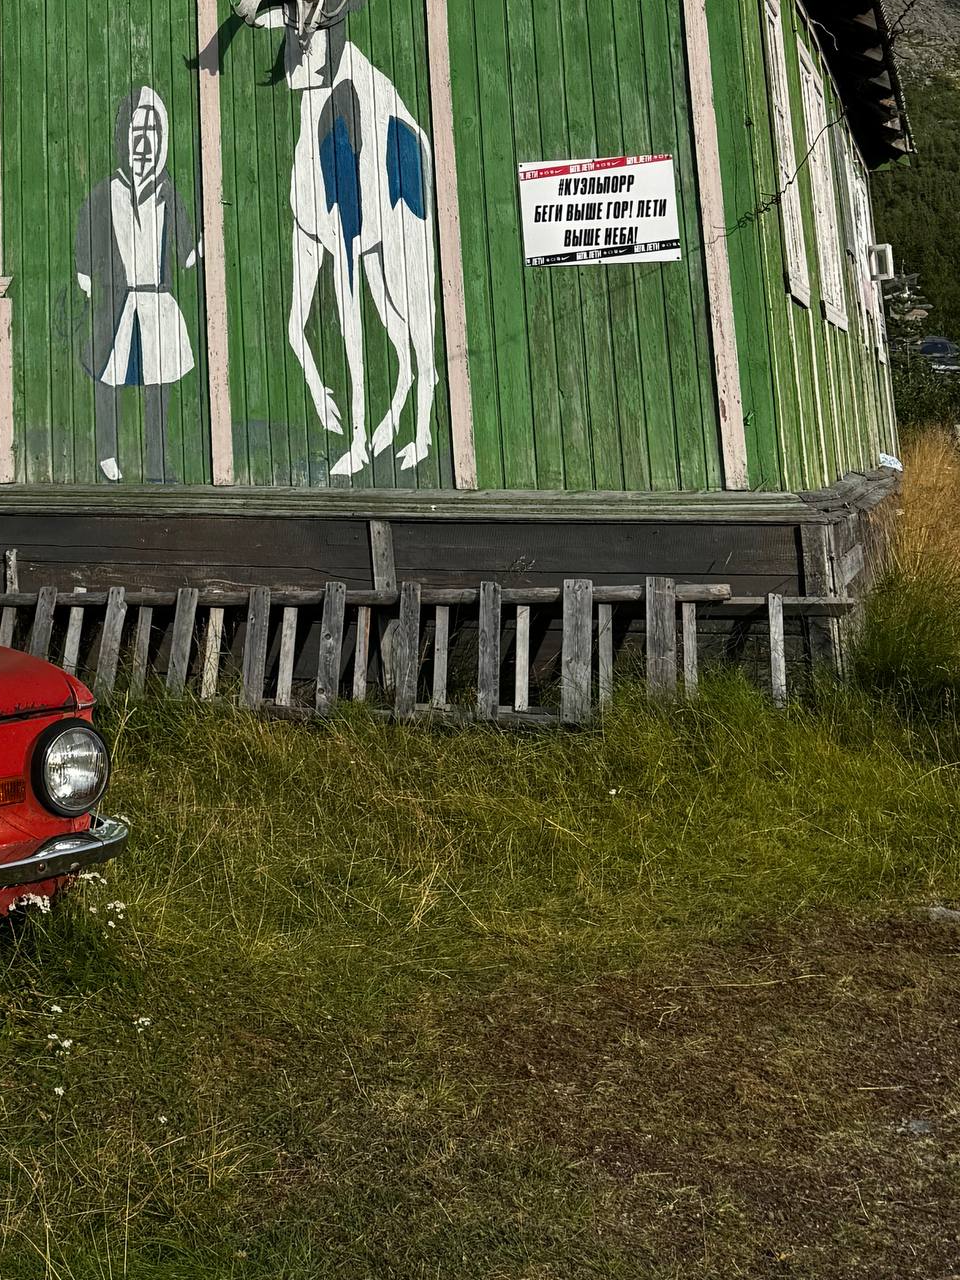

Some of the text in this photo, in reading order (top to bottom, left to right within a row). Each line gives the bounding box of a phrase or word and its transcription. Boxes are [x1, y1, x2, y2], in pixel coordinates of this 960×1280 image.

[558, 174, 635, 196] #КУЭЛЬПОРР
[534, 198, 667, 223] БЕГИ ВЫШЕ ГОР! ЛЕТИ
[563, 226, 639, 247] ВЫШЕ НЕБА!
